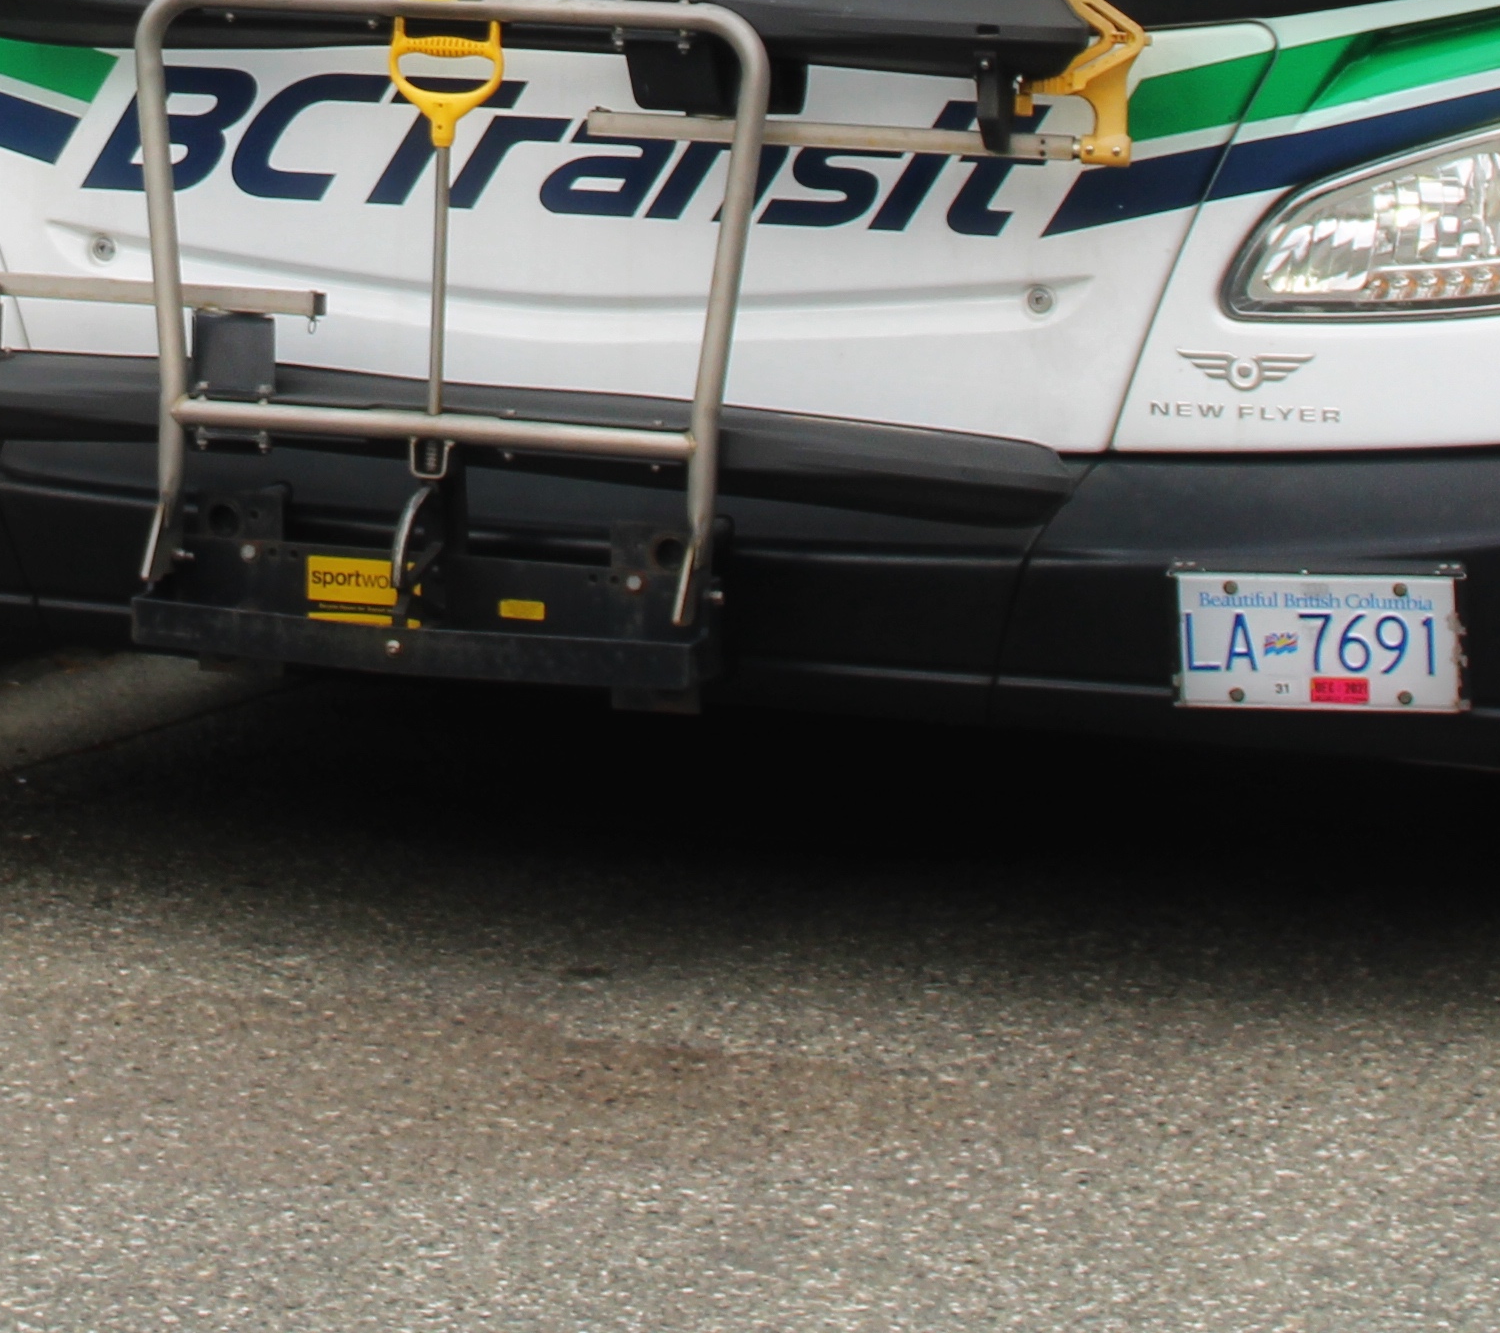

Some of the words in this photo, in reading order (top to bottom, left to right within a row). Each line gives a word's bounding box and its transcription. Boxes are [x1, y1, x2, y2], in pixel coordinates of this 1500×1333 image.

[80, 65, 1052, 238] BCTransit
[1150, 400, 1225, 417] NEW
[1237, 404, 1341, 423] FLYER
[1199, 591, 1278, 608] Beautiful
[1284, 594, 1341, 609] British
[1345, 593, 1433, 612] Columbia
[1183, 612, 1259, 672] LA
[1297, 612, 1436, 676] 7691
[1275, 683, 1290, 694] 31
